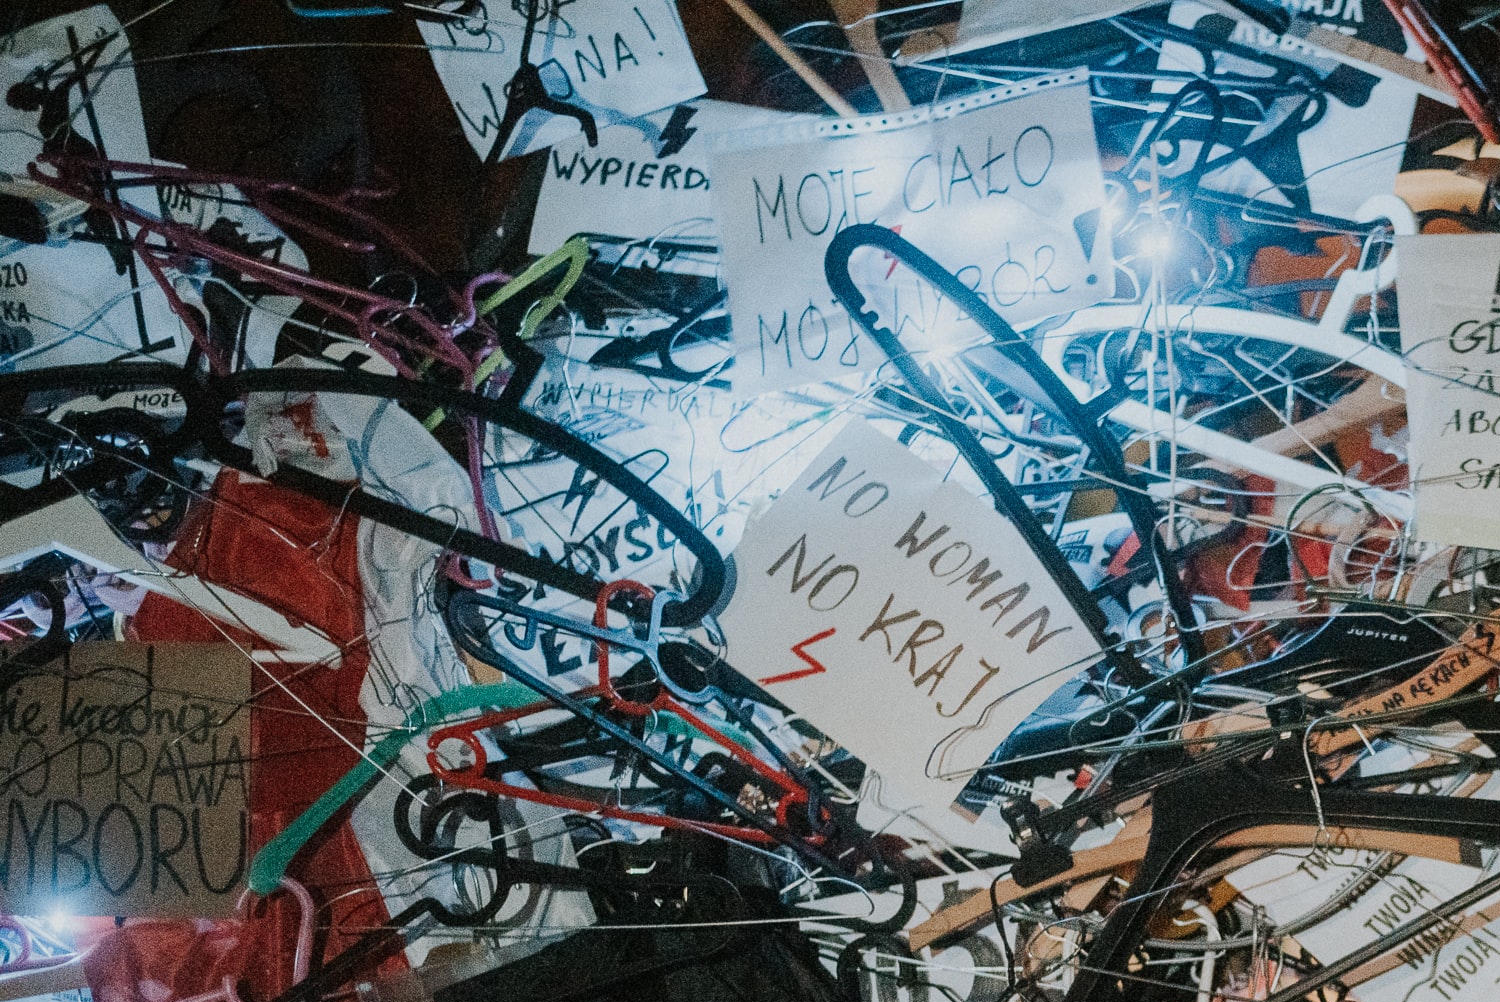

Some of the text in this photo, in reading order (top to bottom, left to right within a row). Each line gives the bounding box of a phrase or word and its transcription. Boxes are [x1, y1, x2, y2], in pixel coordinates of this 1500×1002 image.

[551, 149, 710, 191] WYPIERD
[902, 124, 1054, 214] CIAŁO
[804, 455, 1074, 655] NO WOMAN
[766, 532, 861, 613] NO
[859, 593, 1001, 718] KRAJ
[1345, 625, 1410, 644] JUPITER
[75, 734, 250, 807] PRAWA
[1429, 936, 1496, 1001] TWOJA
